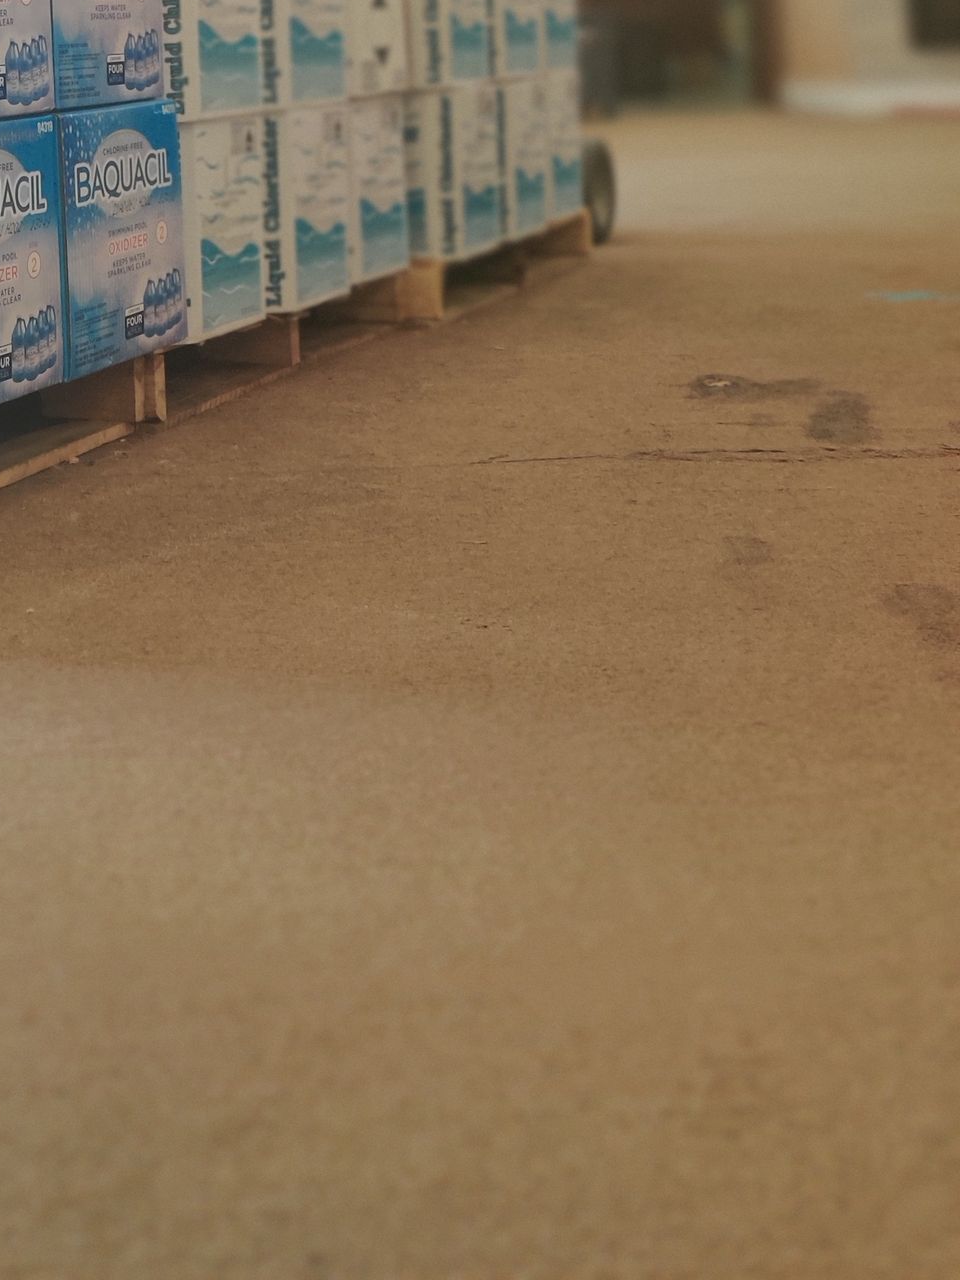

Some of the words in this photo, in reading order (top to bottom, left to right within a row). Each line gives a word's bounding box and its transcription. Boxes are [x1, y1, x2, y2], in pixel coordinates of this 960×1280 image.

[108, 64, 123, 74] FOUR
[166, 41, 190, 115] Liquid
[102, 141, 143, 156] CHLORINE-FREE
[76, 151, 171, 204] BAQUACIL
[109, 233, 148, 255] OXIDIZER
[2, 253, 18, 263] POOL
[112, 258, 129, 268] KEEPS
[129, 252, 146, 264] WATER
[107, 265, 135, 278] SPARKLING
[266, 239, 285, 307] Liquid
[3, 294, 22, 306] CLEAR
[126, 315, 142, 327] FOUR
